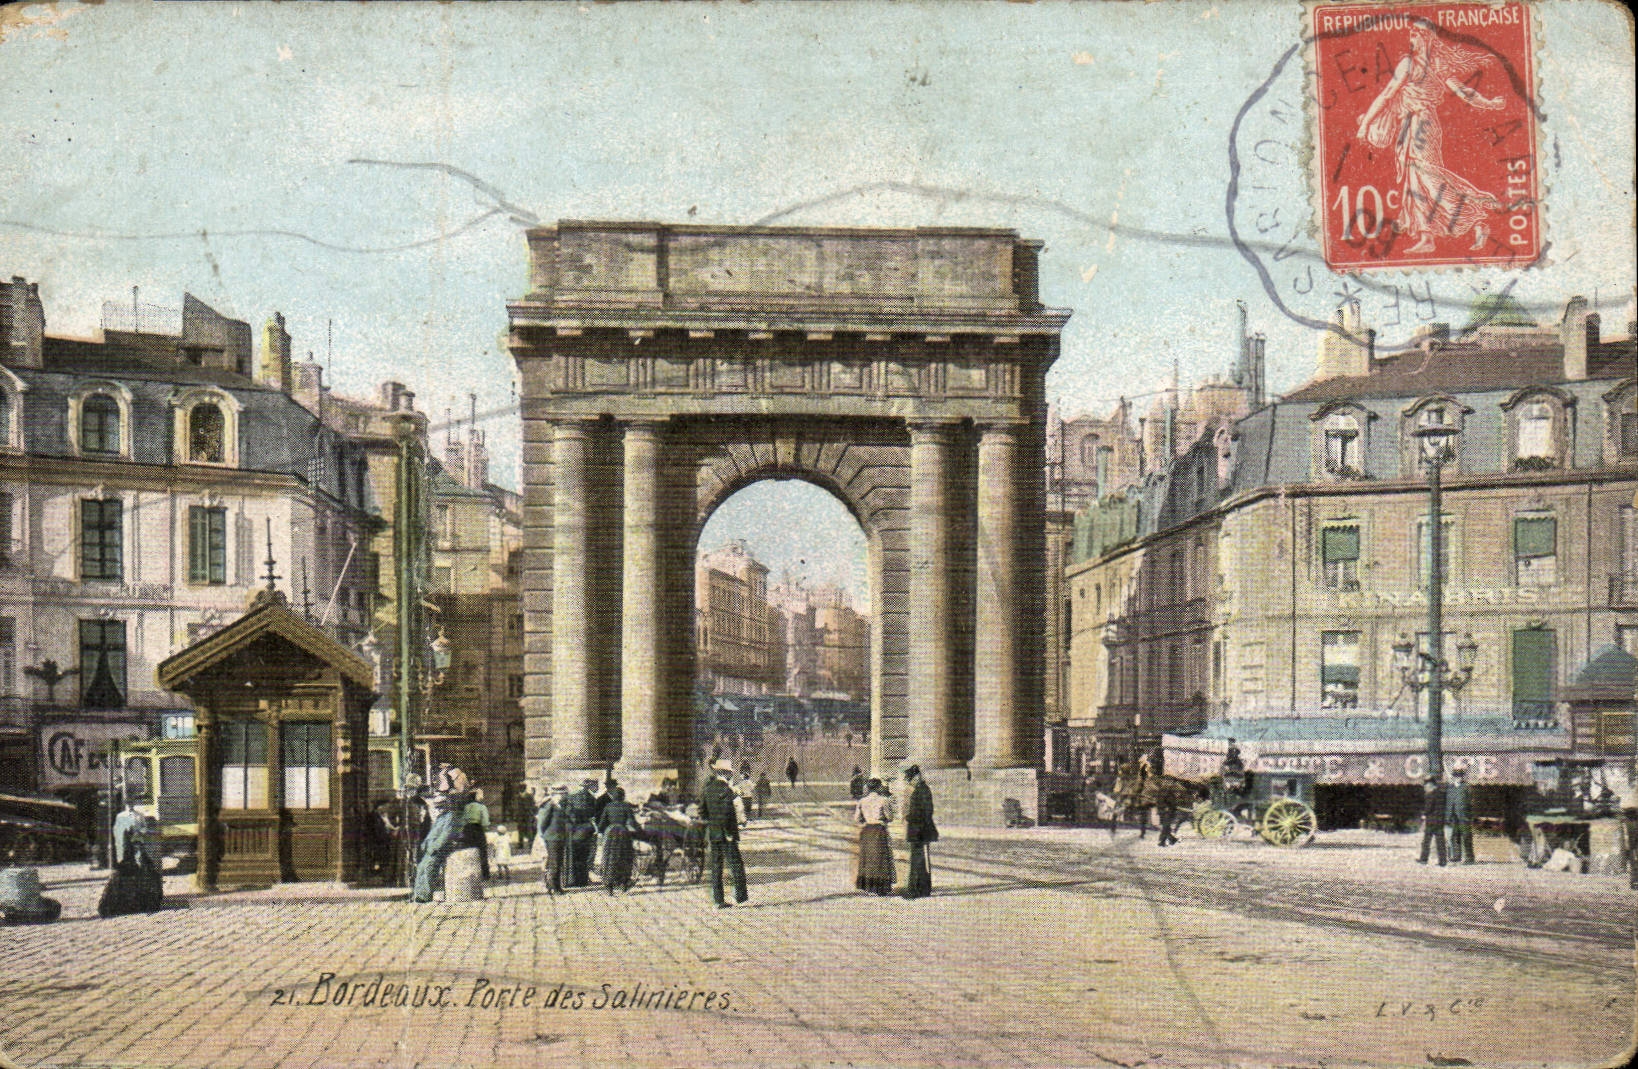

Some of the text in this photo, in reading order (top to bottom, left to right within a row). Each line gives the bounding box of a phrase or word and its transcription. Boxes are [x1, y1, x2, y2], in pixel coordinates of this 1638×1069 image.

[1437, 6, 1521, 28] FRANÇAISE
[1508, 158, 1529, 247] POSTES
[1363, 758, 1386, 780] &
